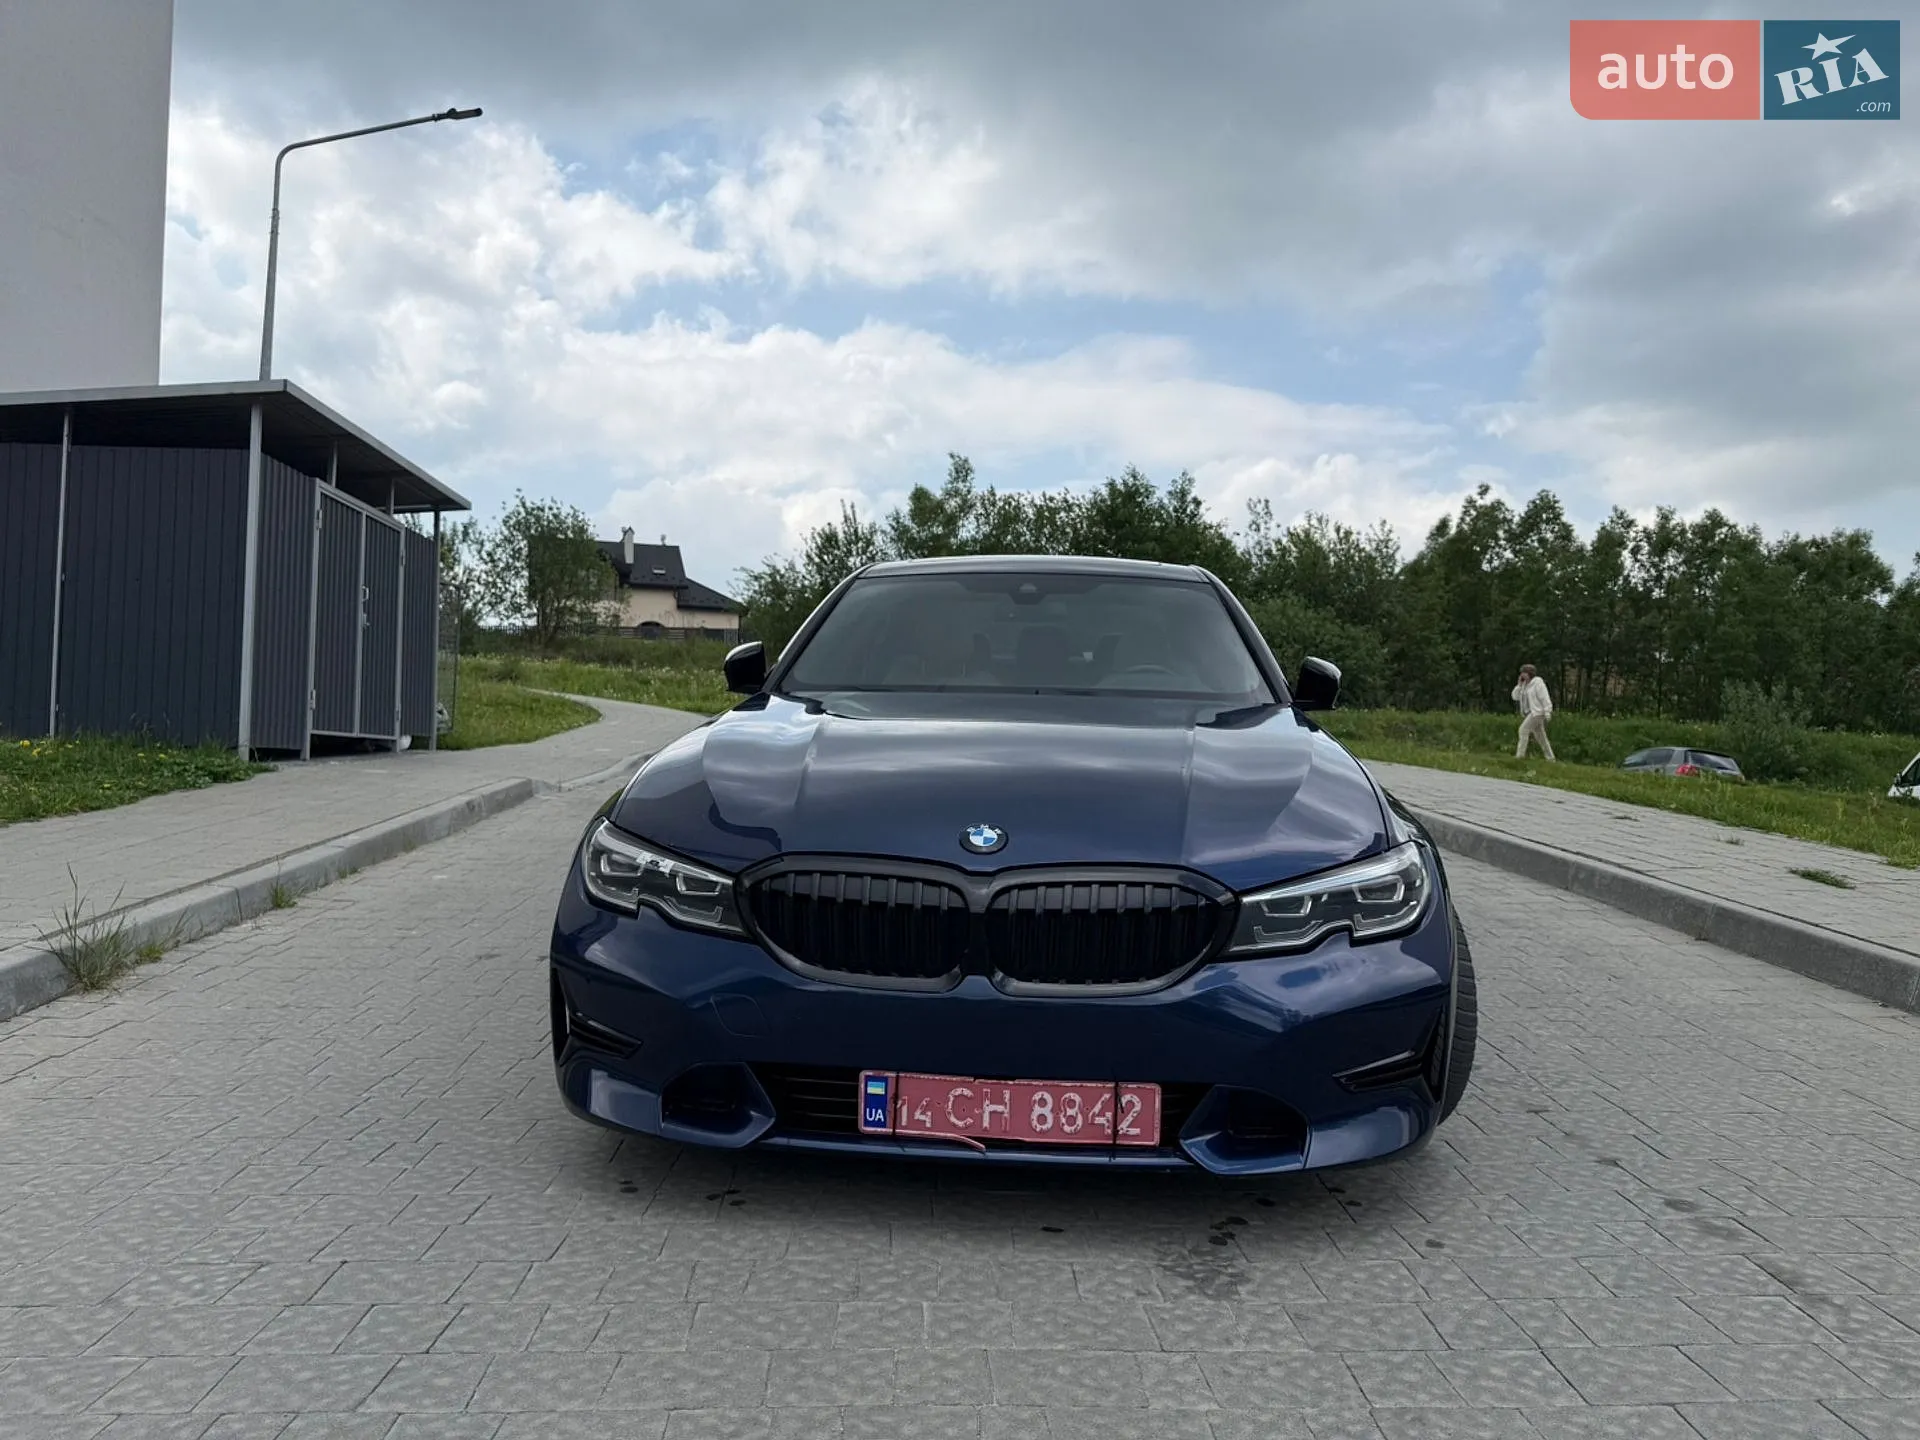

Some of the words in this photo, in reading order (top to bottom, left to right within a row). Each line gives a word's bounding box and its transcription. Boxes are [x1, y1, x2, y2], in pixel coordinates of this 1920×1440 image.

[866, 1107, 885, 1123] UA
[896, 1095, 933, 1128] 14
[945, 1087, 1011, 1132] CH
[1030, 1090, 1142, 1136] 8842
